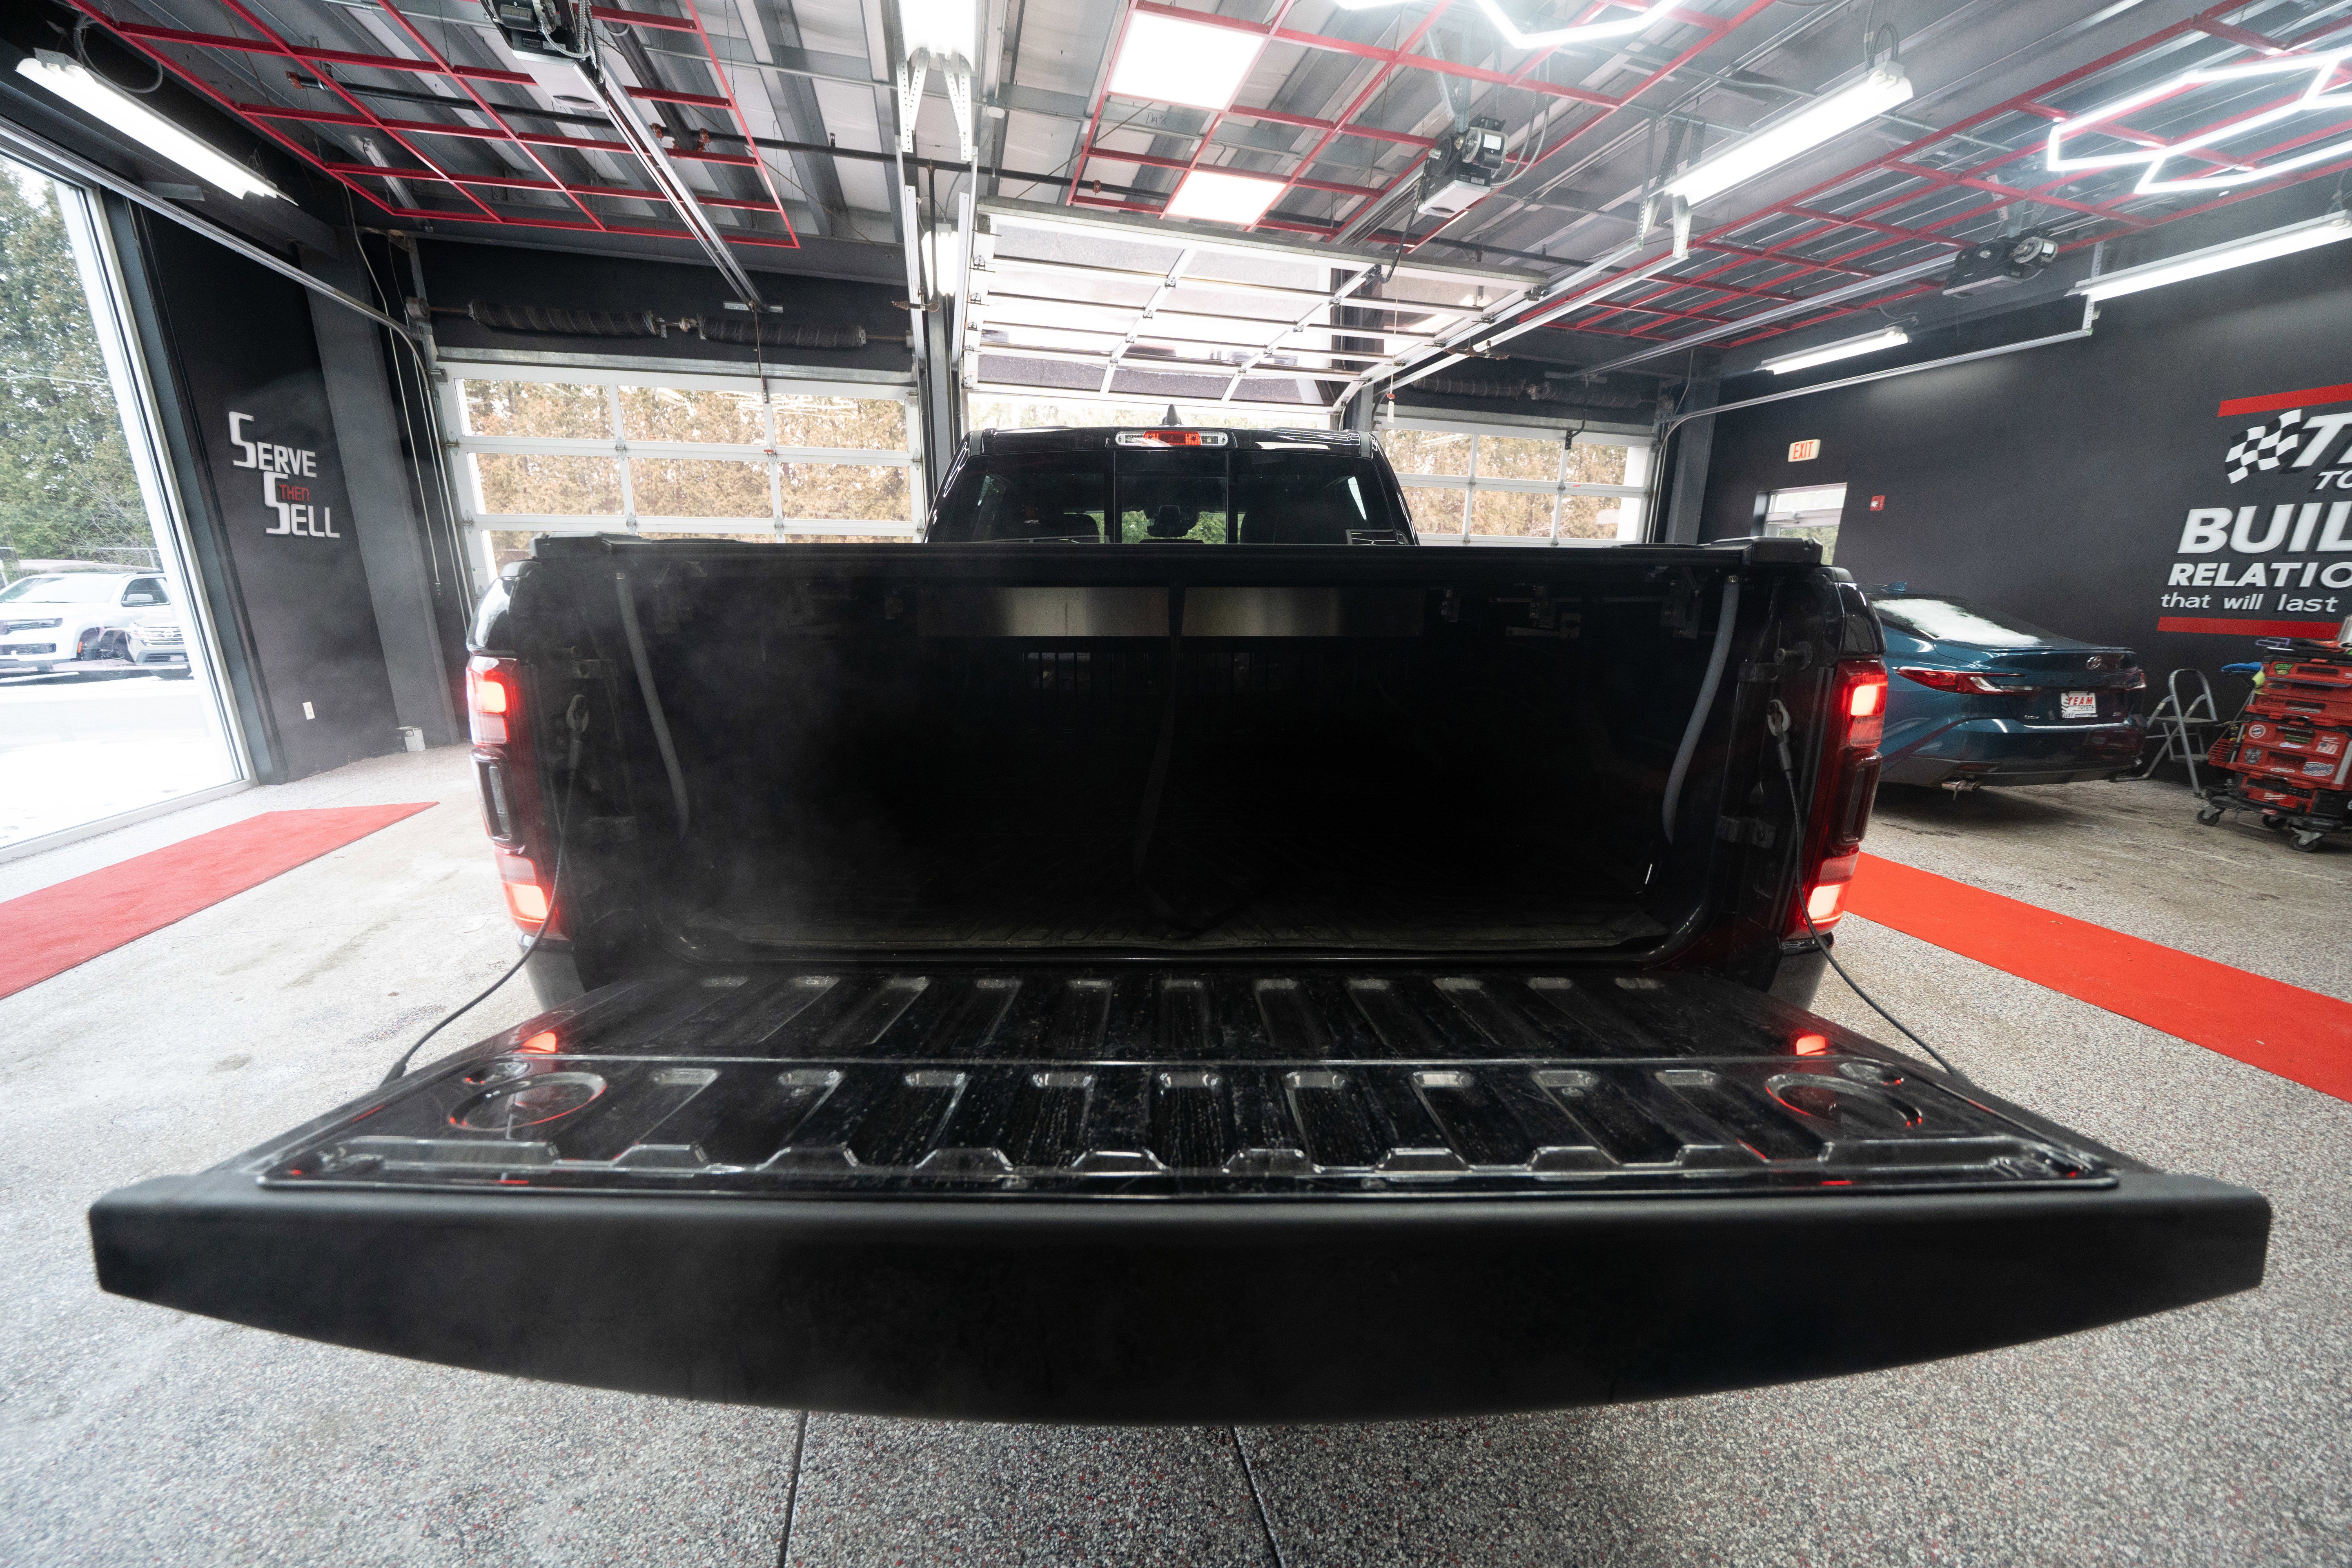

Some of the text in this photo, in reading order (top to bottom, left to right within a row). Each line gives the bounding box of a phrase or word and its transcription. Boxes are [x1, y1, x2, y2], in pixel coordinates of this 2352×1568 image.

[229, 411, 317, 478] SERVE
[1793, 441, 1813, 459] EXIT
[279, 484, 310, 501] THEN
[263, 471, 340, 538] SELL
[2177, 501, 2352, 554] BUIL
[2167, 561, 2352, 588] RELATIO
[2161, 592, 2338, 612] that will last
[2068, 697, 2093, 705] TEAM
